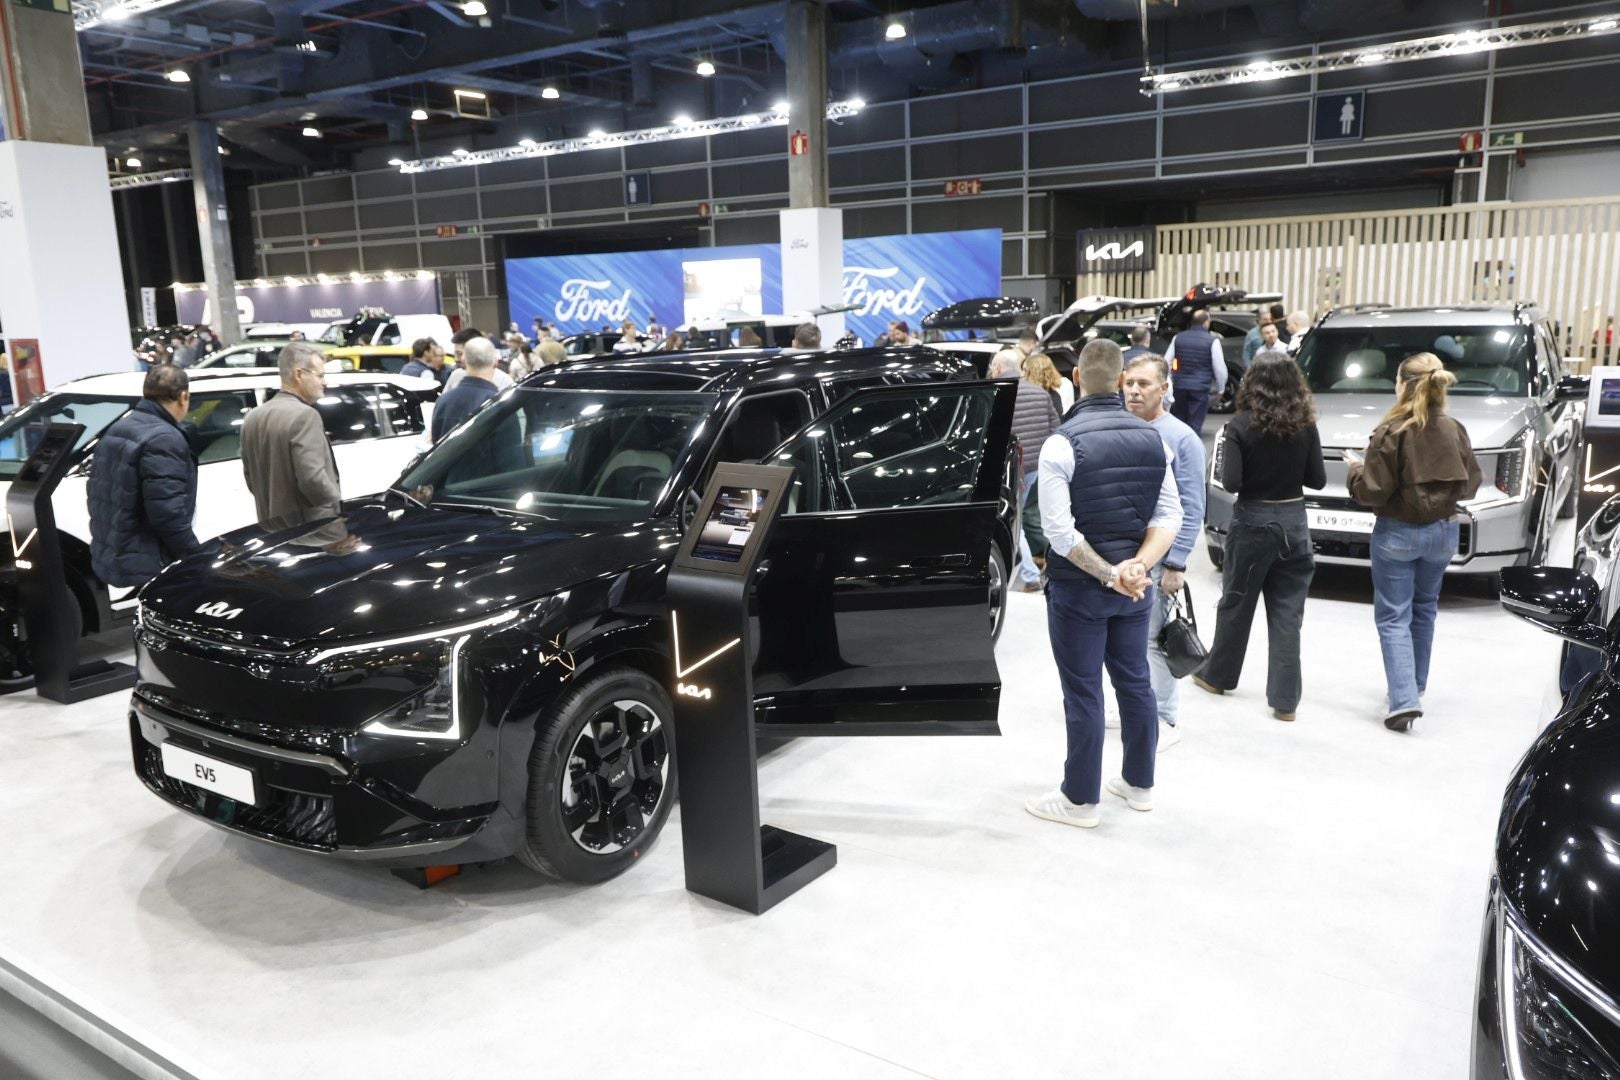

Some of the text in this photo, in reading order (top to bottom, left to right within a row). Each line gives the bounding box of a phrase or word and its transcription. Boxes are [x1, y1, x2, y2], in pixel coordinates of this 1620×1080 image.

[1086, 241, 1144, 260] KIA
[555, 279, 631, 322] Ford
[1317, 515, 1337, 525] EV9
[194, 601, 244, 620] KIA
[677, 682, 712, 699] KIA
[195, 763, 216, 783] EV5
